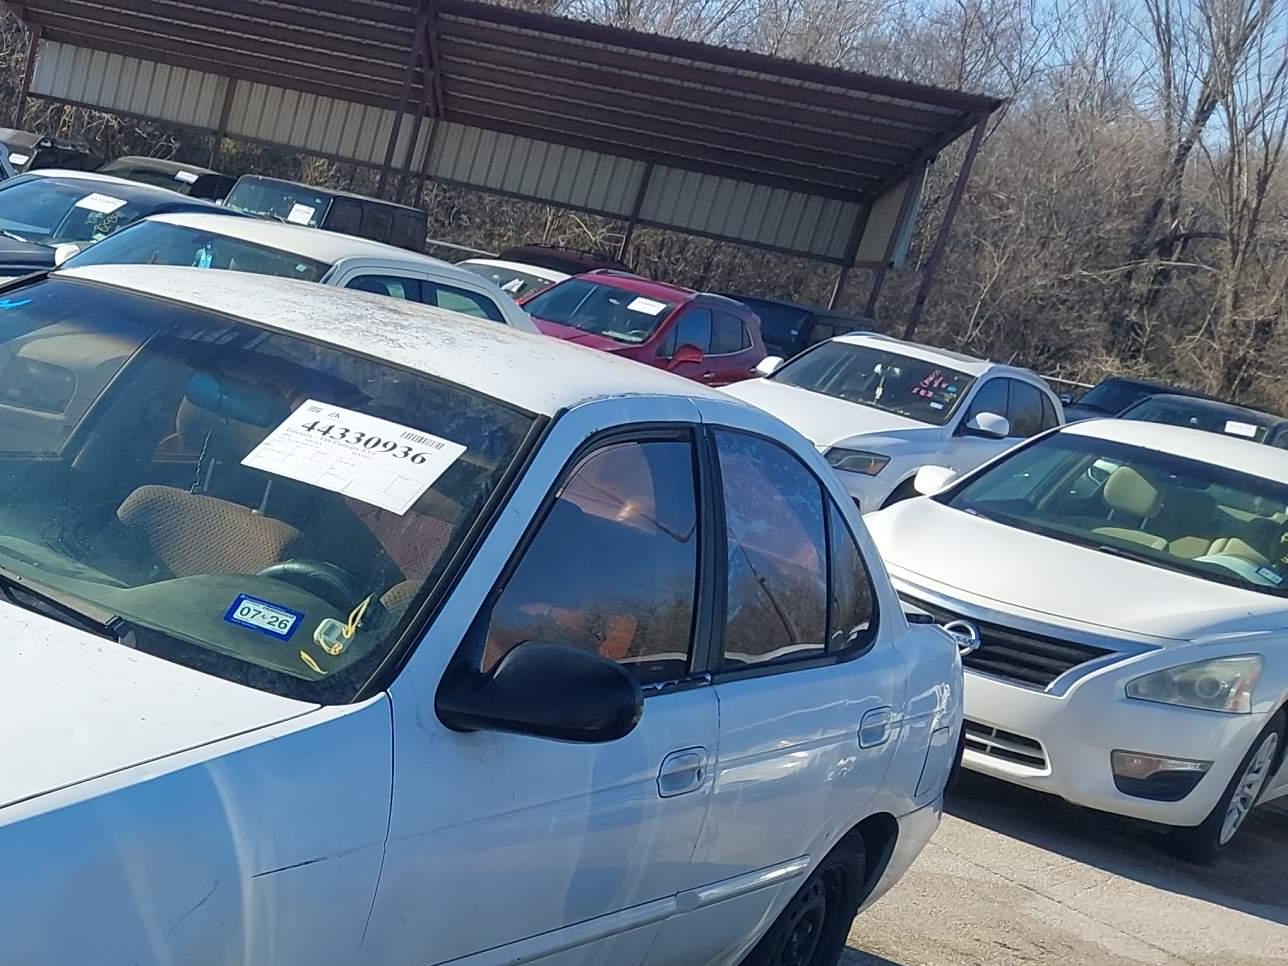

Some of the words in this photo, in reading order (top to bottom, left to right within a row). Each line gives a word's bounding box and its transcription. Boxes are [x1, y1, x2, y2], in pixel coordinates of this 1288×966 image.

[301, 420, 432, 465] 44330936
[239, 606, 263, 619] 07
[266, 615, 290, 630] 26
